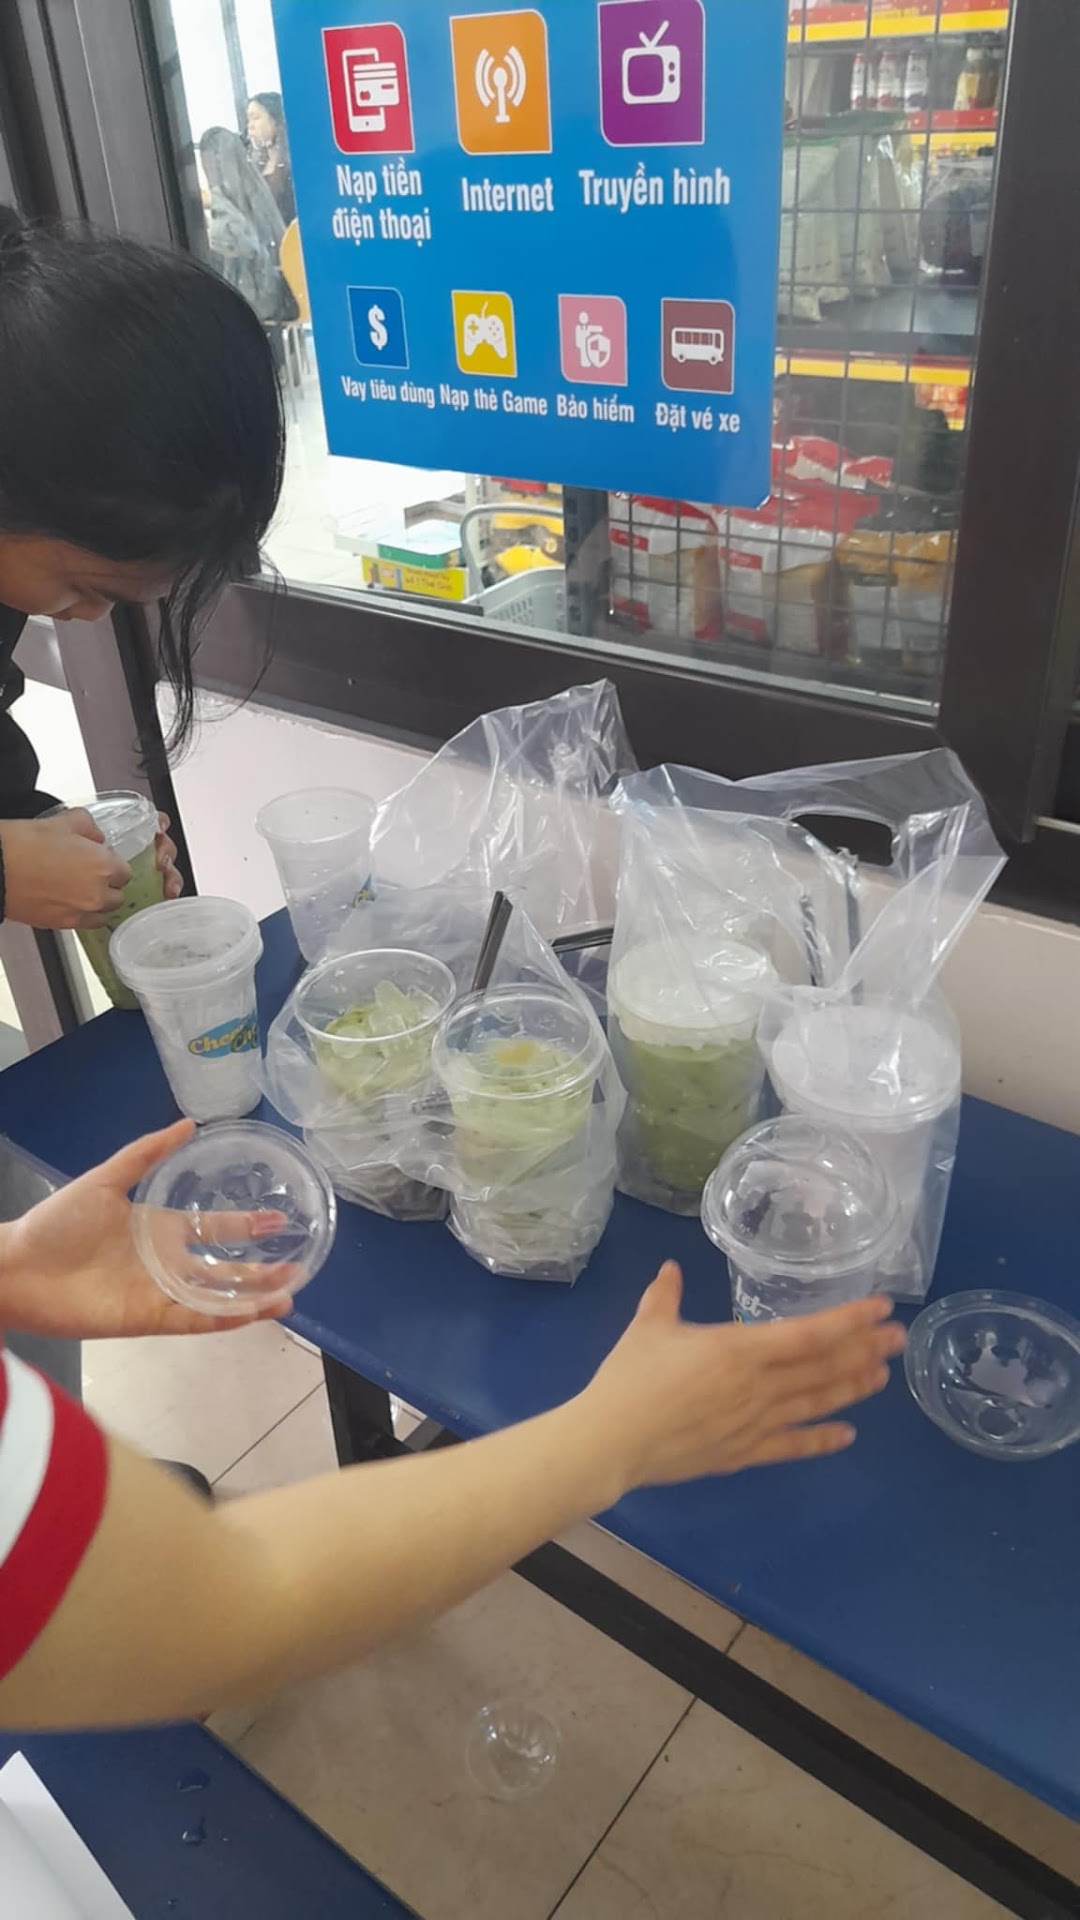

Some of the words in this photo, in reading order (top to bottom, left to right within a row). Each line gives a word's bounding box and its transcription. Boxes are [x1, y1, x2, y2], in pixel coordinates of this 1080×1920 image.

[335, 163, 378, 204] Nạp
[382, 156, 423, 197] tiền
[461, 176, 555, 213] Internet
[578, 161, 665, 214] Truyền
[673, 167, 731, 206] hình
[332, 207, 375, 246] điện
[379, 207, 432, 247] thoại
[341, 375, 366, 402] Vay
[370, 378, 397, 401] tiêu
[400, 381, 436, 410] dùng
[439, 383, 470, 412] Nạp
[474, 387, 499, 411] thẻ
[502, 390, 549, 416] Game
[556, 393, 589, 420] Bảo
[593, 393, 635, 424] hiểm
[655, 402, 687, 433] Đặt
[691, 406, 713, 431] vé
[718, 412, 740, 434] xe
